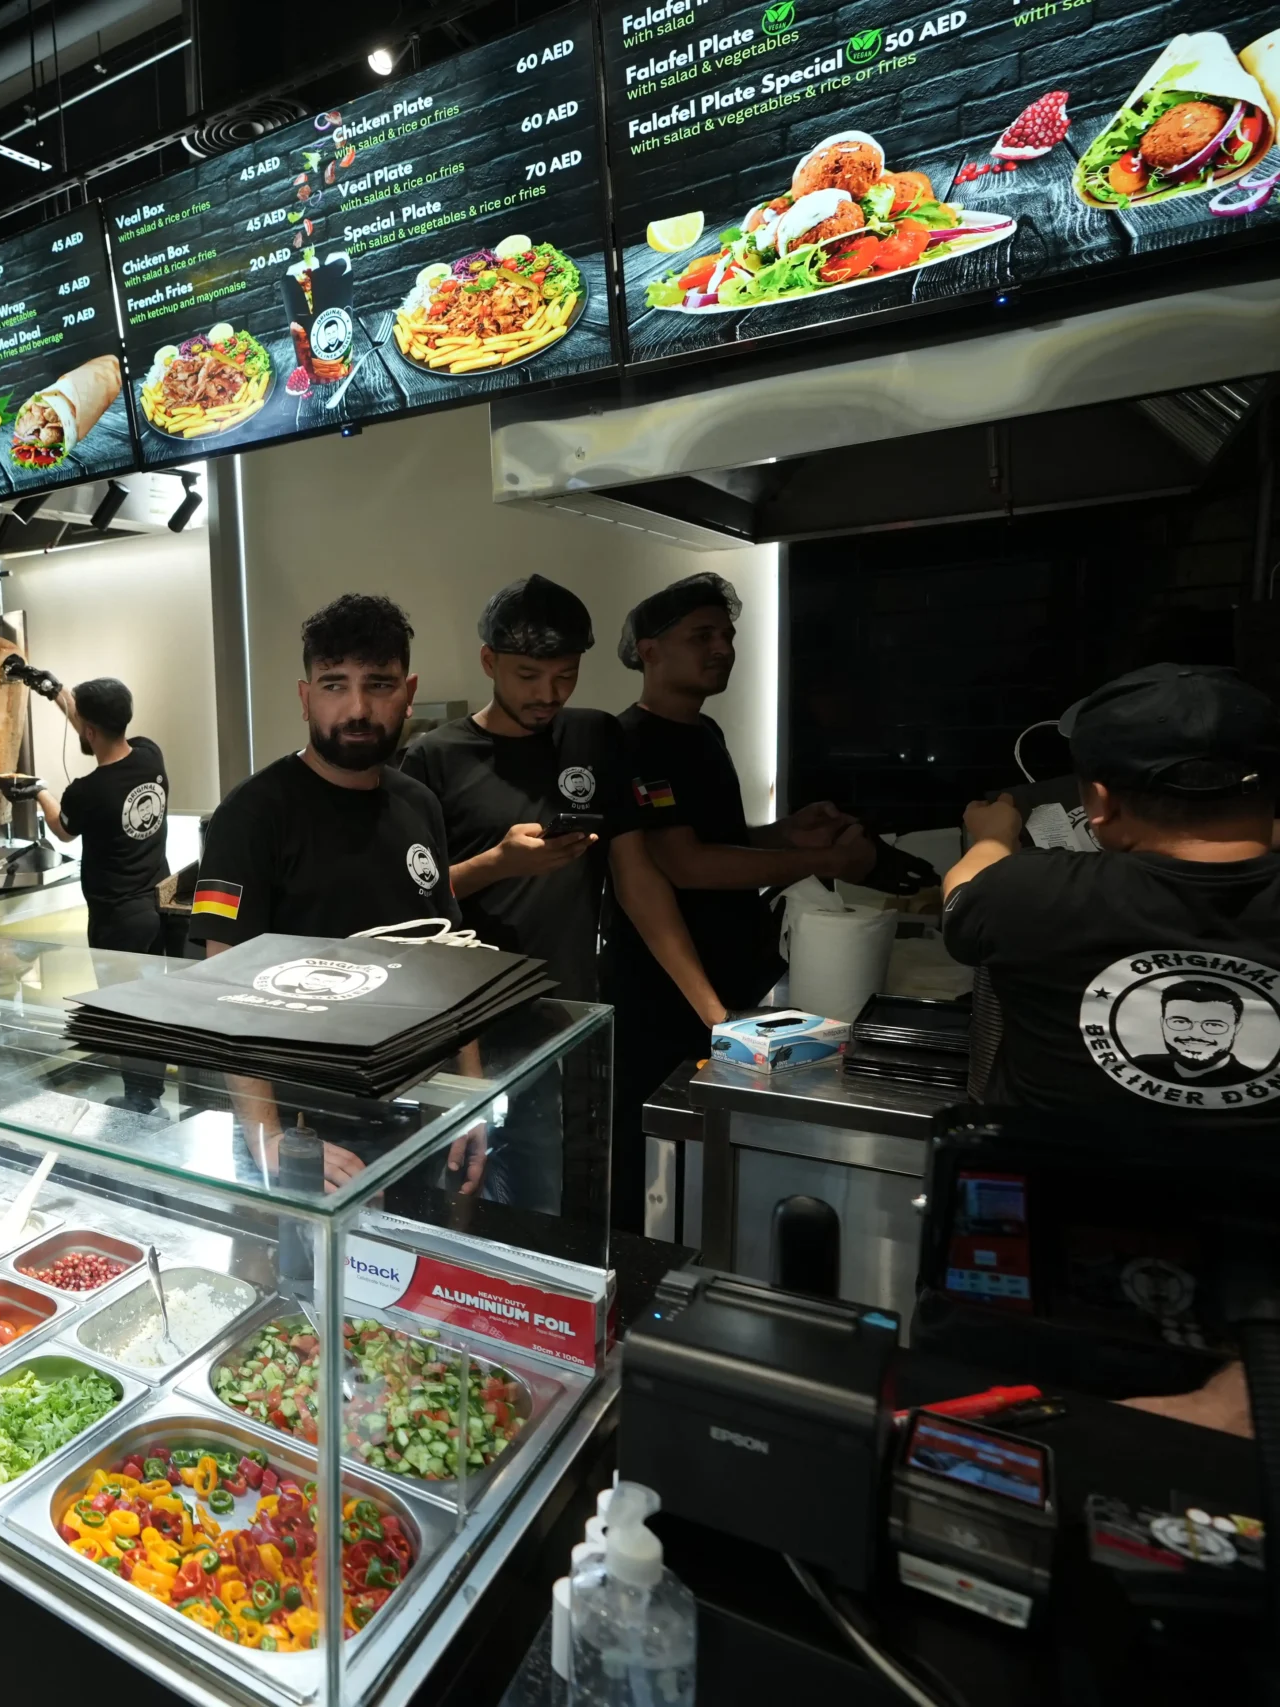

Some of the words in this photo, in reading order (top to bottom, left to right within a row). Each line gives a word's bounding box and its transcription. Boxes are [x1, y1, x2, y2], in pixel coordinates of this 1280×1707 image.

[622, 0, 691, 35] Falafel
[623, 29, 653, 48] with
[657, 11, 695, 36] salad
[768, 22, 787, 31] VEGAN
[1013, 2, 1056, 27] with
[885, 28, 913, 51] 50
[919, 10, 966, 41] AED
[516, 53, 537, 73] 60
[541, 40, 573, 64] AED
[626, 43, 694, 84] Falafel
[699, 29, 754, 59] Plate
[628, 82, 656, 98] with
[661, 66, 697, 87] salad
[702, 61, 711, 73] &
[716, 31, 798, 67] vegetables
[853, 51, 873, 60] VEGAN
[629, 99, 695, 138] Falafel
[701, 87, 755, 114] Plate
[761, 48, 842, 94] Special
[632, 138, 659, 152] with
[664, 124, 701, 143] salad
[704, 119, 714, 130] &
[718, 94, 800, 125] vegetables
[805, 85, 816, 97] &
[821, 76, 851, 90] rice
[856, 71, 871, 80] or
[878, 54, 916, 71] fries
[332, 116, 391, 143] Chicken
[393, 96, 433, 121] Plate
[521, 113, 542, 132] 60
[546, 101, 578, 124] AED
[334, 144, 356, 160] with
[358, 133, 384, 148] salad
[388, 128, 395, 138] &
[401, 122, 418, 131] rice
[421, 117, 431, 125] or
[435, 107, 459, 117] fries
[240, 166, 254, 180] 45
[257, 157, 280, 175] AED
[338, 173, 371, 198] Veal
[374, 163, 413, 186] Plate
[525, 161, 546, 180] 70
[549, 150, 581, 172] AED
[341, 198, 360, 210] with
[363, 188, 392, 203] salad
[393, 184, 401, 193] &
[405, 177, 423, 187] rice
[426, 173, 436, 181] or
[440, 164, 464, 175] fries
[115, 208, 141, 229] Veal
[142, 203, 165, 219] Box
[117, 230, 135, 243] with
[136, 222, 156, 236] salad
[158, 218, 164, 227] &
[165, 213, 180, 224] rice
[181, 209, 190, 218] or
[191, 201, 211, 214] fries
[246, 216, 261, 231] 45
[263, 208, 286, 227] AED
[344, 211, 395, 243] Special
[402, 201, 442, 223] Plate
[345, 241, 367, 255] with
[369, 232, 395, 247] salad
[399, 229, 405, 238] &
[408, 212, 465, 234] vegetables
[469, 207, 477, 216] &
[479, 199, 501, 212] rice
[520, 185, 545, 196] fries
[52, 239, 63, 252] 45
[65, 232, 83, 248] AED
[122, 254, 165, 275] Chicken
[167, 244, 190, 260] Box
[124, 275, 140, 288] with
[142, 267, 162, 282] salad
[164, 265, 170, 274] &
[171, 260, 186, 271] rice
[187, 257, 196, 266] or
[198, 248, 217, 262] fries
[250, 256, 265, 271] 20
[267, 248, 290, 265] AED
[58, 282, 70, 295] 45
[72, 276, 90, 291] AED
[127, 289, 164, 312] French
[165, 281, 193, 299] Fries
[62, 314, 75, 327] 70
[77, 307, 94, 322] AED
[129, 312, 146, 325] with
[147, 302, 178, 319] ketchup
[180, 296, 195, 308] and
[196, 281, 247, 303] mayonnaise
[317, 309, 342, 325] ORIGINAL
[3, 348, 18, 358] fries
[19, 342, 31, 353] and
[32, 332, 63, 348] beverage
[19, 326, 40, 343] Deal
[127, 785, 155, 803] ORIGINAL
[1130, 953, 1280, 990] ORIGINAL
[1085, 1023, 1204, 1105] BERLINER
[431, 1284, 529, 1323] ALUMINIUM
[533, 1313, 576, 1336] FOIL
[478, 1291, 503, 1303] HEAVY
[505, 1298, 526, 1309] DUTY
[532, 1343, 554, 1356] 30cm
[563, 1352, 585, 1365] 100m
[709, 1425, 769, 1455] EPSON
